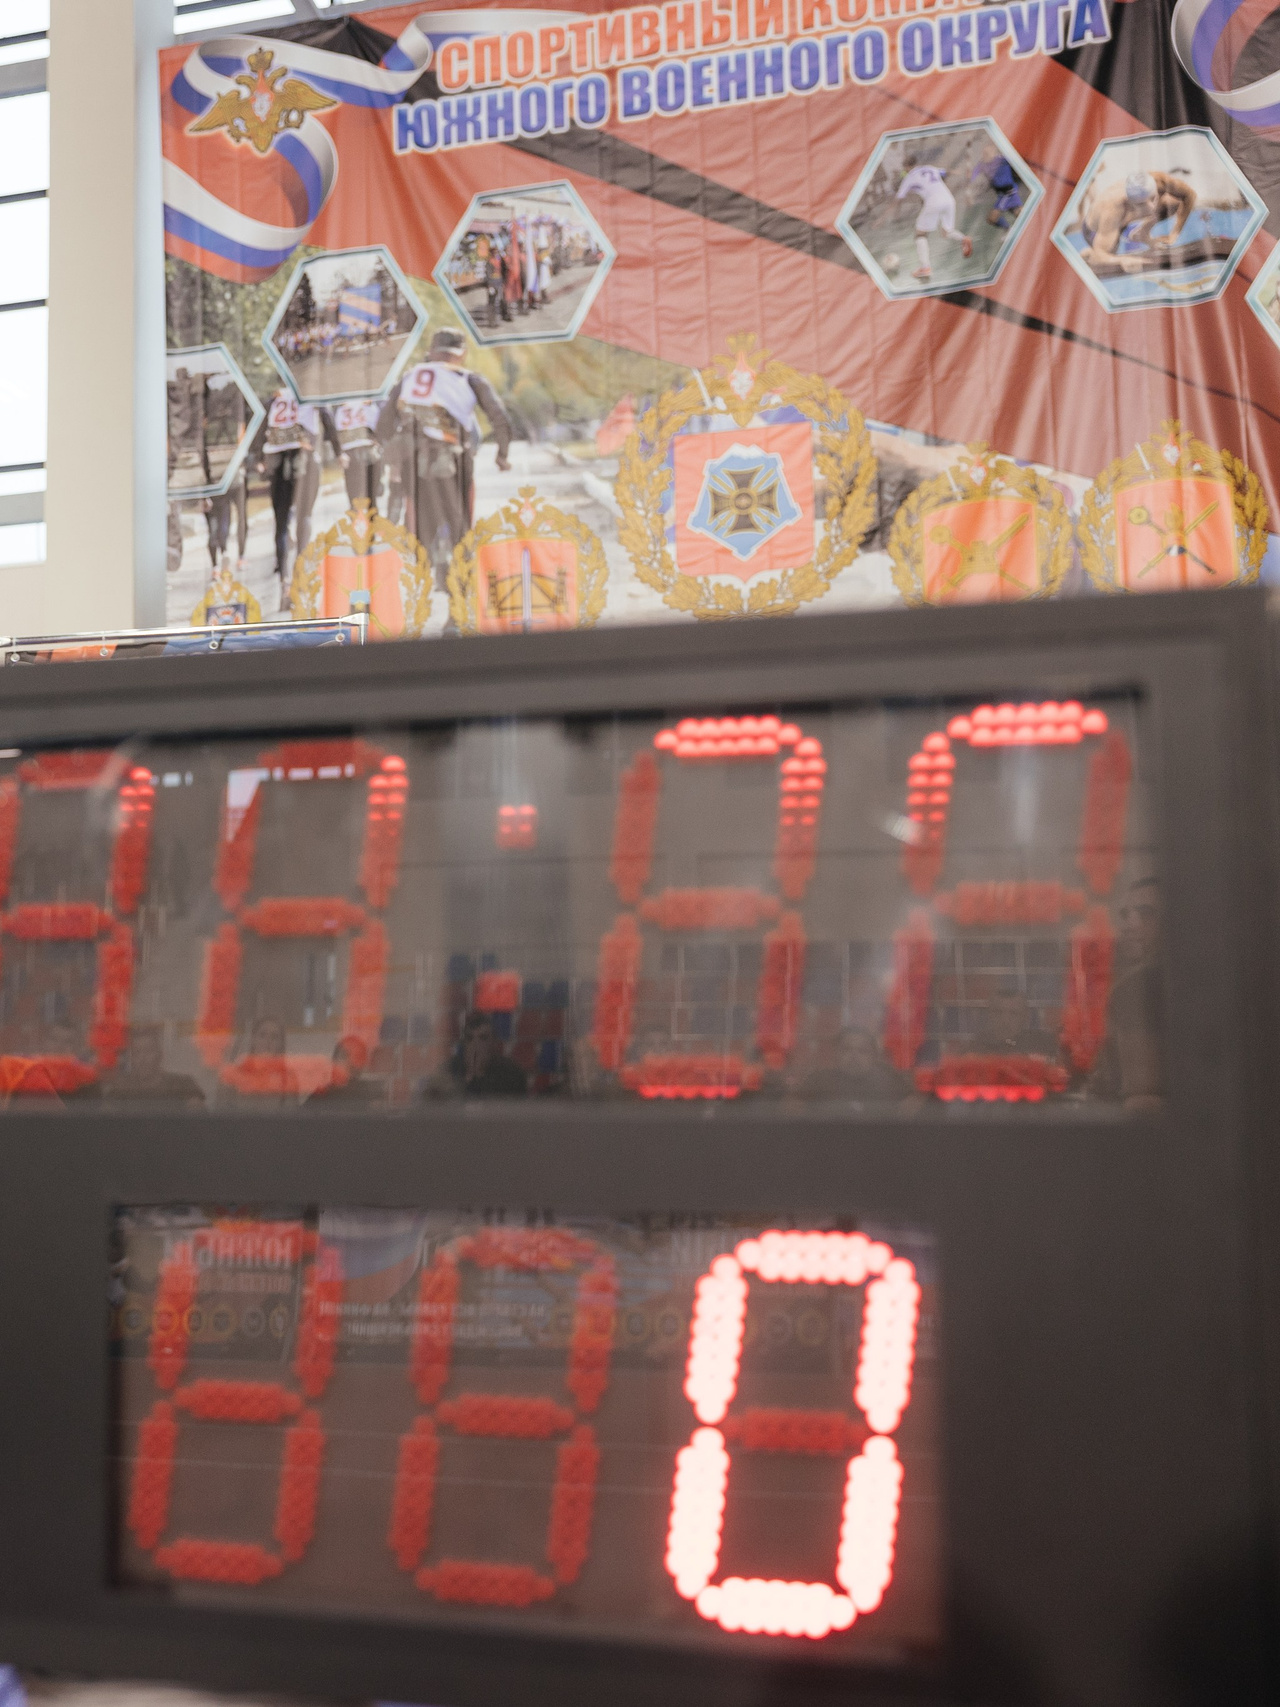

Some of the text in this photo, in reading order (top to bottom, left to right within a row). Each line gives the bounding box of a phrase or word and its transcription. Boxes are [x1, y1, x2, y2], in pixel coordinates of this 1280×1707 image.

[396, 0, 1107, 151] ЮЖНОГО ВОЕННОГО ОКРУГА
[412, 369, 436, 399] 9
